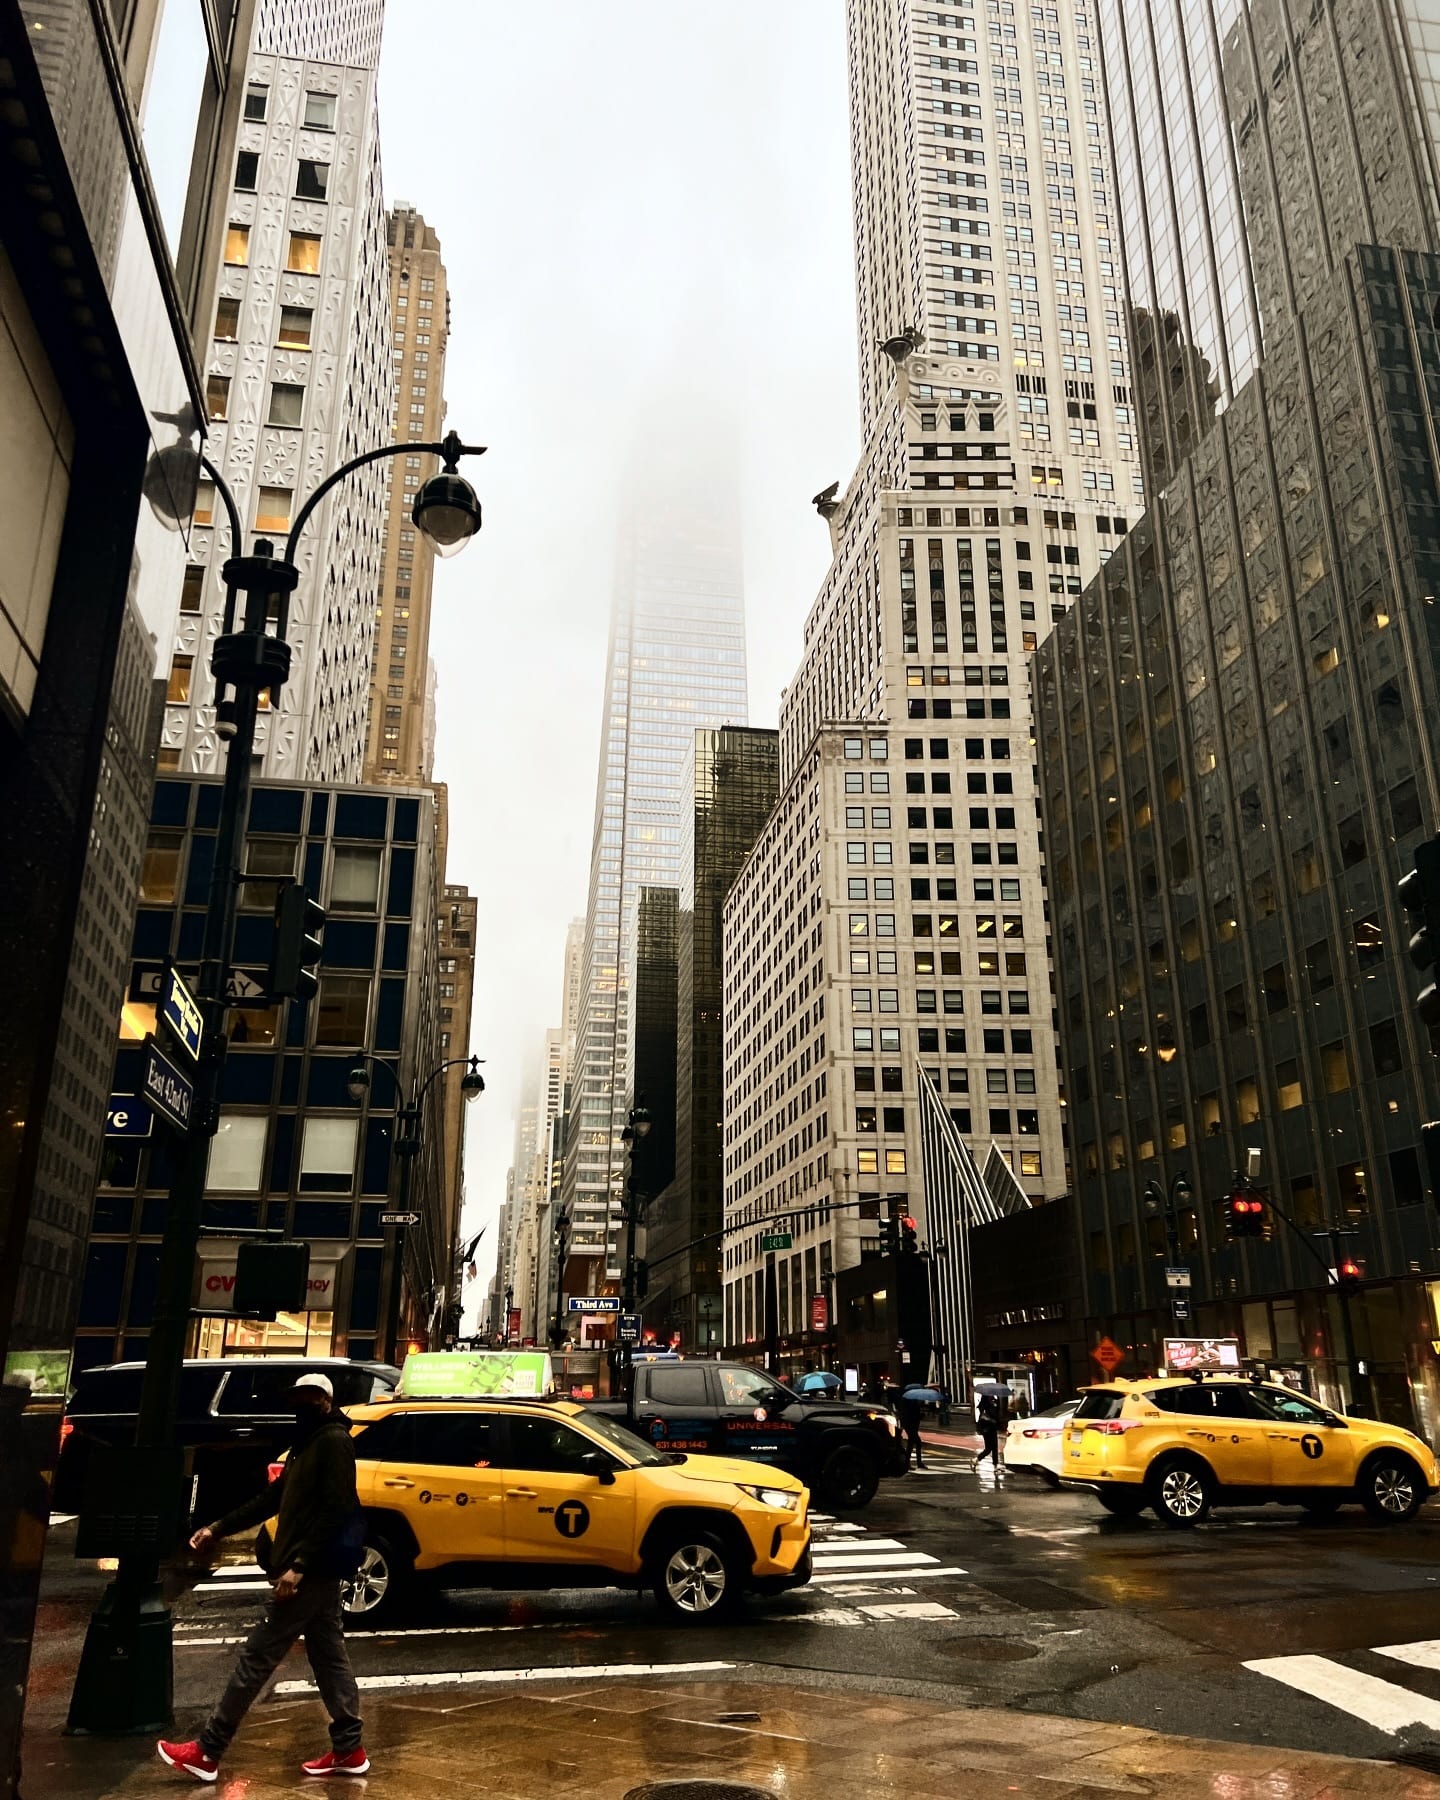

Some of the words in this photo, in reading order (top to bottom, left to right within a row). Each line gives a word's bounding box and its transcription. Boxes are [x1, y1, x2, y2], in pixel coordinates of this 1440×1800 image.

[227, 980, 251, 996] AY
[148, 1058, 165, 1097] East
[165, 1077, 183, 1112] 42nd
[181, 1091, 189, 1120] St
[205, 1275, 238, 1293] CV
[576, 1300, 597, 1309] Third
[599, 1300, 614, 1309] Ave
[727, 1422, 796, 1430] UNIVERSAL
[1305, 1438, 1318, 1456] T
[563, 1508, 582, 1533] T
